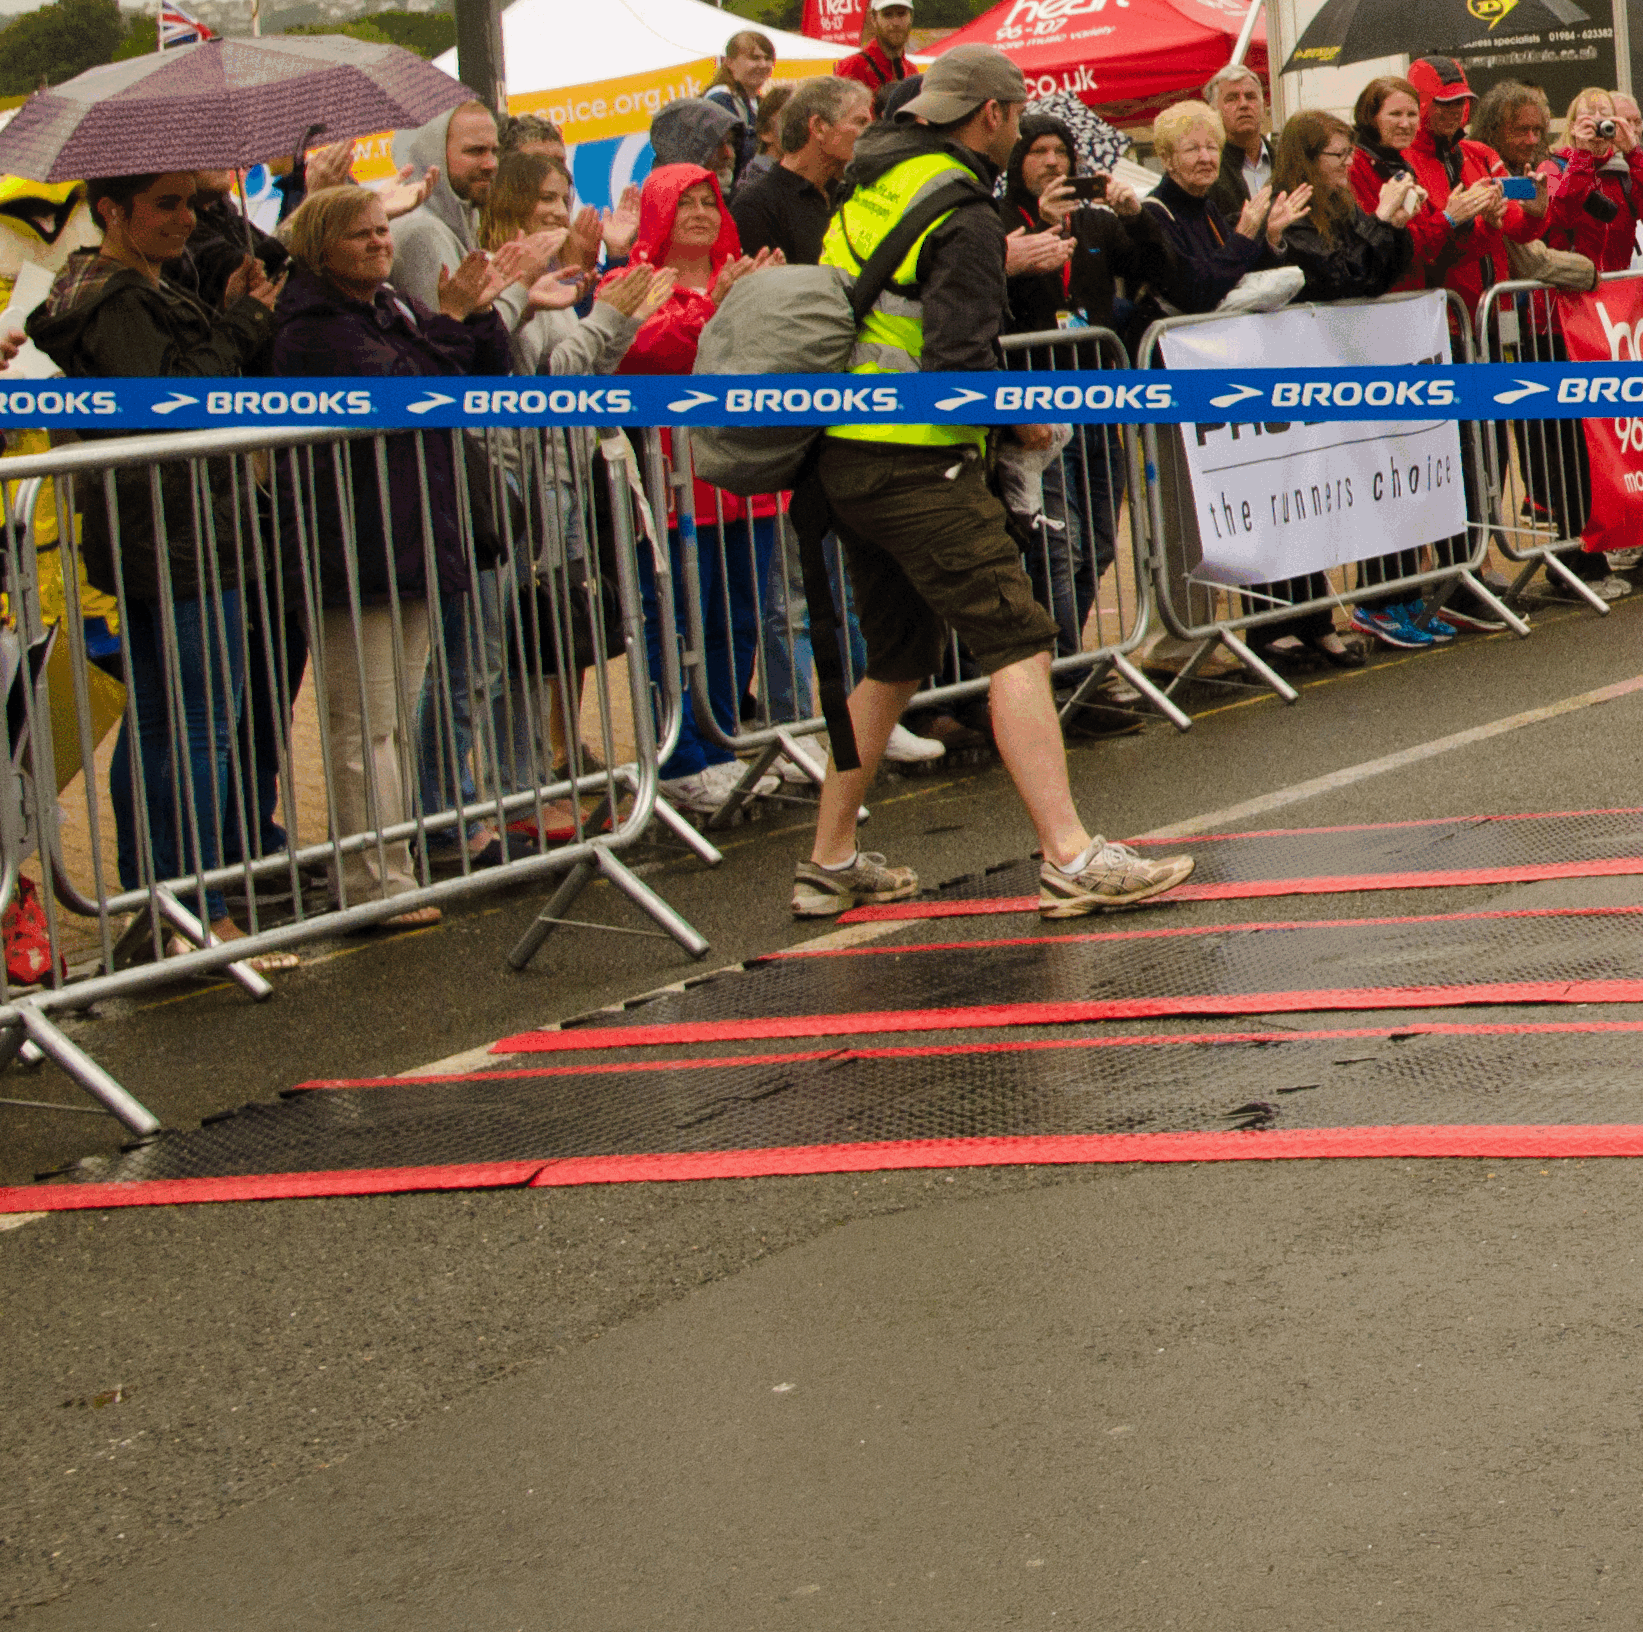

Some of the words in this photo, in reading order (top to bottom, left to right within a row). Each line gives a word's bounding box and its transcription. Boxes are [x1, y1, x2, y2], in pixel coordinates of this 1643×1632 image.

[207, 392, 371, 414] BROOKS
[464, 390, 631, 413] BROOKS
[726, 388, 897, 412] BROOKS
[995, 384, 1172, 410] BROOKS
[1271, 380, 1455, 407] BROOKS
[1210, 491, 1253, 539] the
[1270, 475, 1354, 527] runners
[1372, 455, 1452, 502] choice
